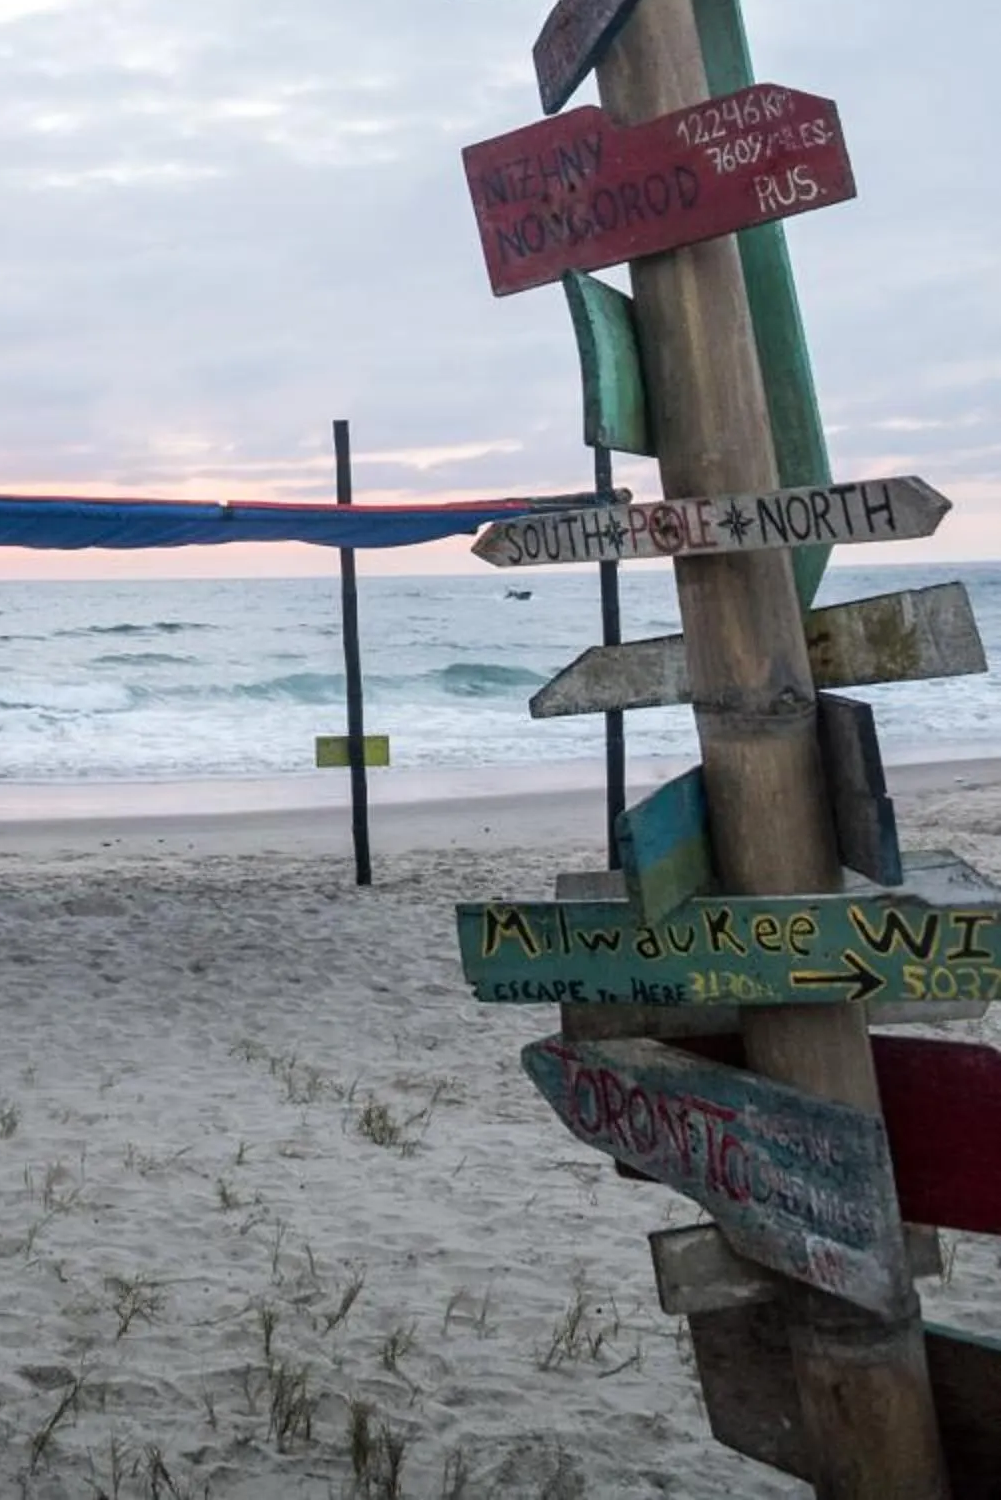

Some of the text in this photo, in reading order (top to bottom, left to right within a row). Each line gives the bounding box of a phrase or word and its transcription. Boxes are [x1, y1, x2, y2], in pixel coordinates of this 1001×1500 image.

[480, 131, 604, 208] NIZHNY
[504, 482, 896, 564] SOUTH POLE NORTH
[846, 902, 998, 964] WI
[492, 977, 589, 1003] ESCAPE
[629, 974, 689, 1003] HERE
